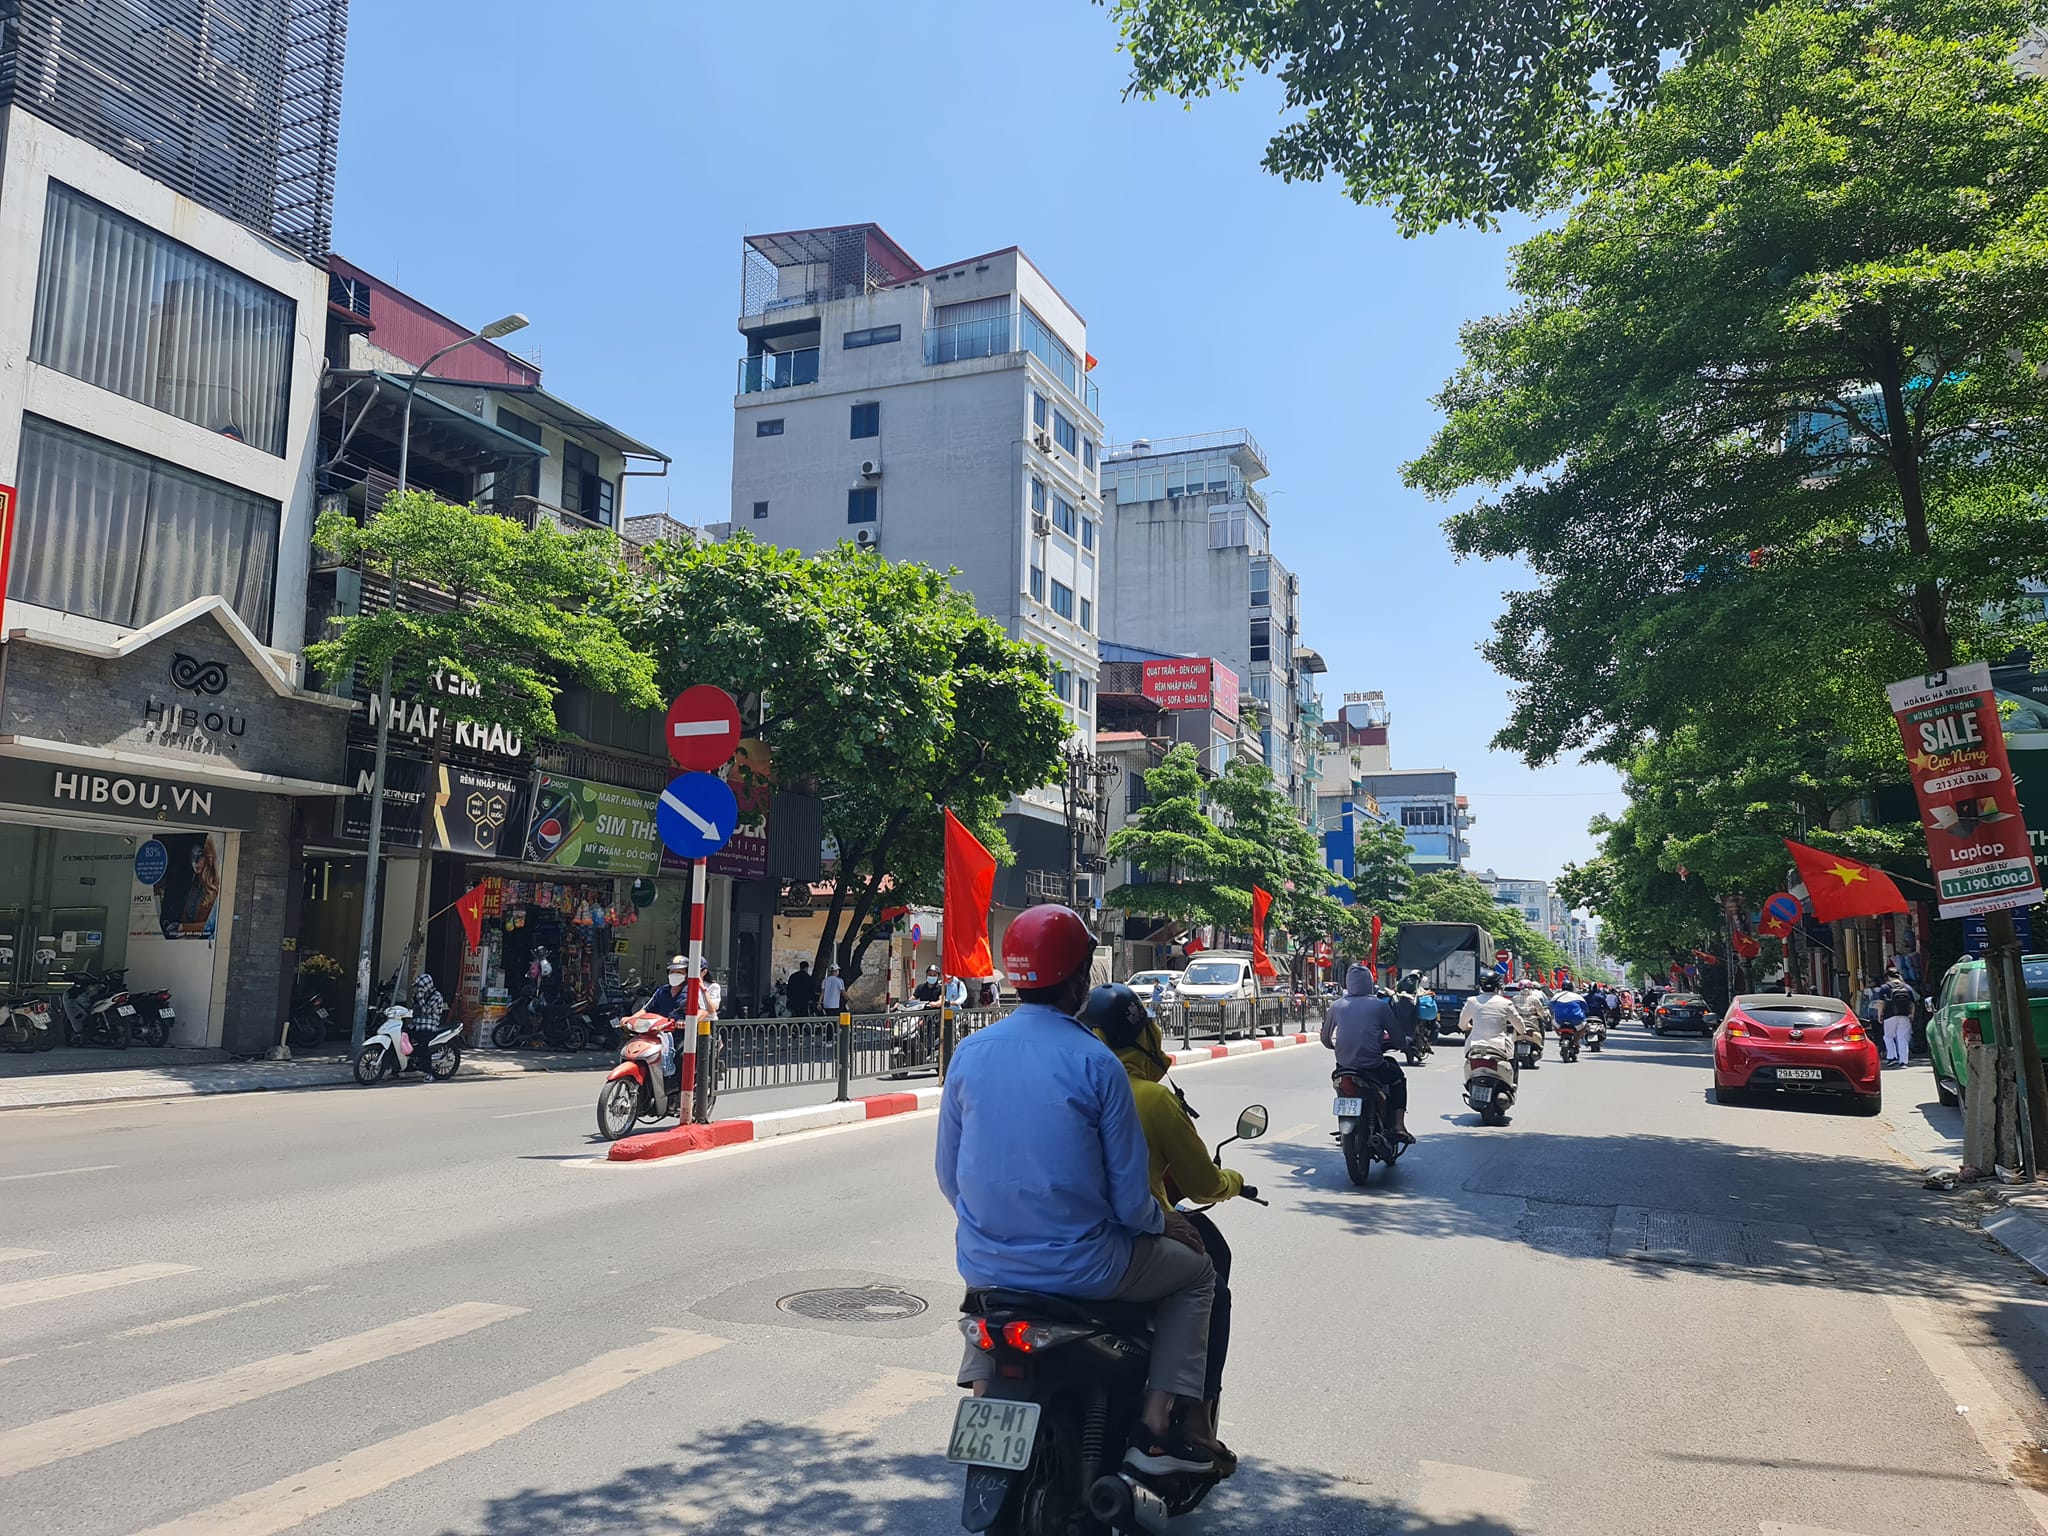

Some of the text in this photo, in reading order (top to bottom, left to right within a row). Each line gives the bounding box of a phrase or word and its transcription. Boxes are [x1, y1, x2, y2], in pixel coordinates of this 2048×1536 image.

[1945, 684, 1978, 696] MOBILE
[1167, 695, 1181, 705] SOFA
[144, 701, 247, 736] HIBOU
[1919, 711, 1983, 752] SALE
[1951, 747, 1989, 766] Nóng
[460, 773, 516, 793] RÈM NHẬP KHẨU
[550, 780, 569, 790] pepsi
[1936, 780, 1952, 790] 213
[54, 771, 213, 817] HIBOU.VN
[599, 792, 620, 801] MART
[596, 814, 627, 837] SIM
[145, 847, 161, 858] 83%
[1950, 843, 2005, 862] Laptop
[1946, 871, 2029, 894] 11.190.000đ
[966, 1403, 1027, 1433] 29-M1
[953, 1431, 1027, 1464] 446.19
